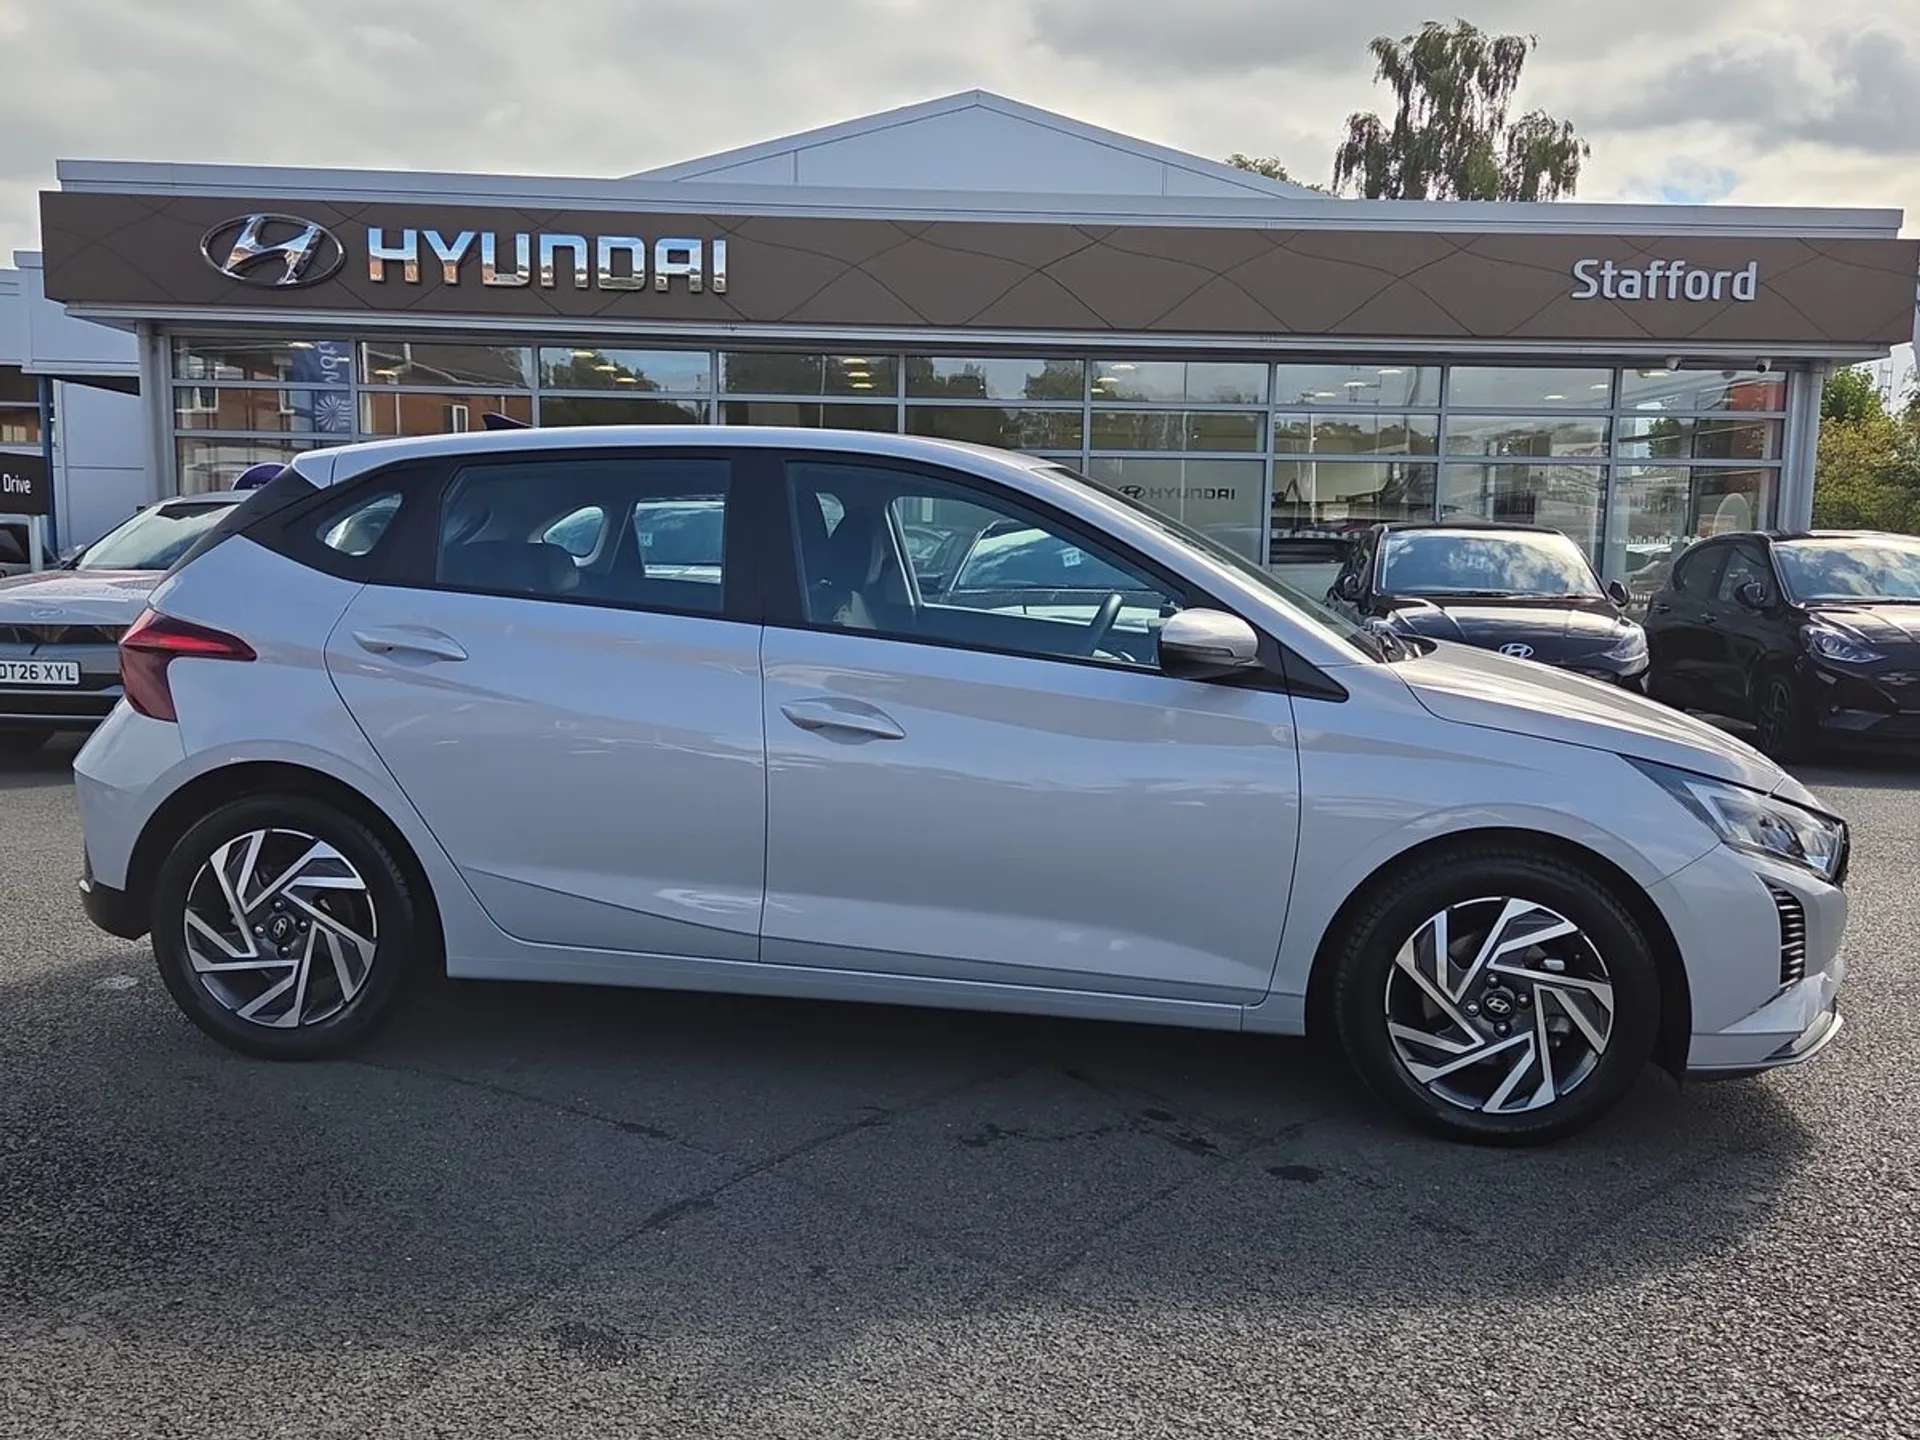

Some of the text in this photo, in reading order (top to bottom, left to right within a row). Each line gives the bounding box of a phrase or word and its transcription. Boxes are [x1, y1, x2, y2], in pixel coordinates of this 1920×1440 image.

[368, 228, 727, 293] HYUNDAI
[1571, 259, 1758, 301] Stafford
[3, 473, 32, 494] Drive
[1150, 487, 1235, 500] HYUNDAI
[44, 664, 76, 681] XYL
